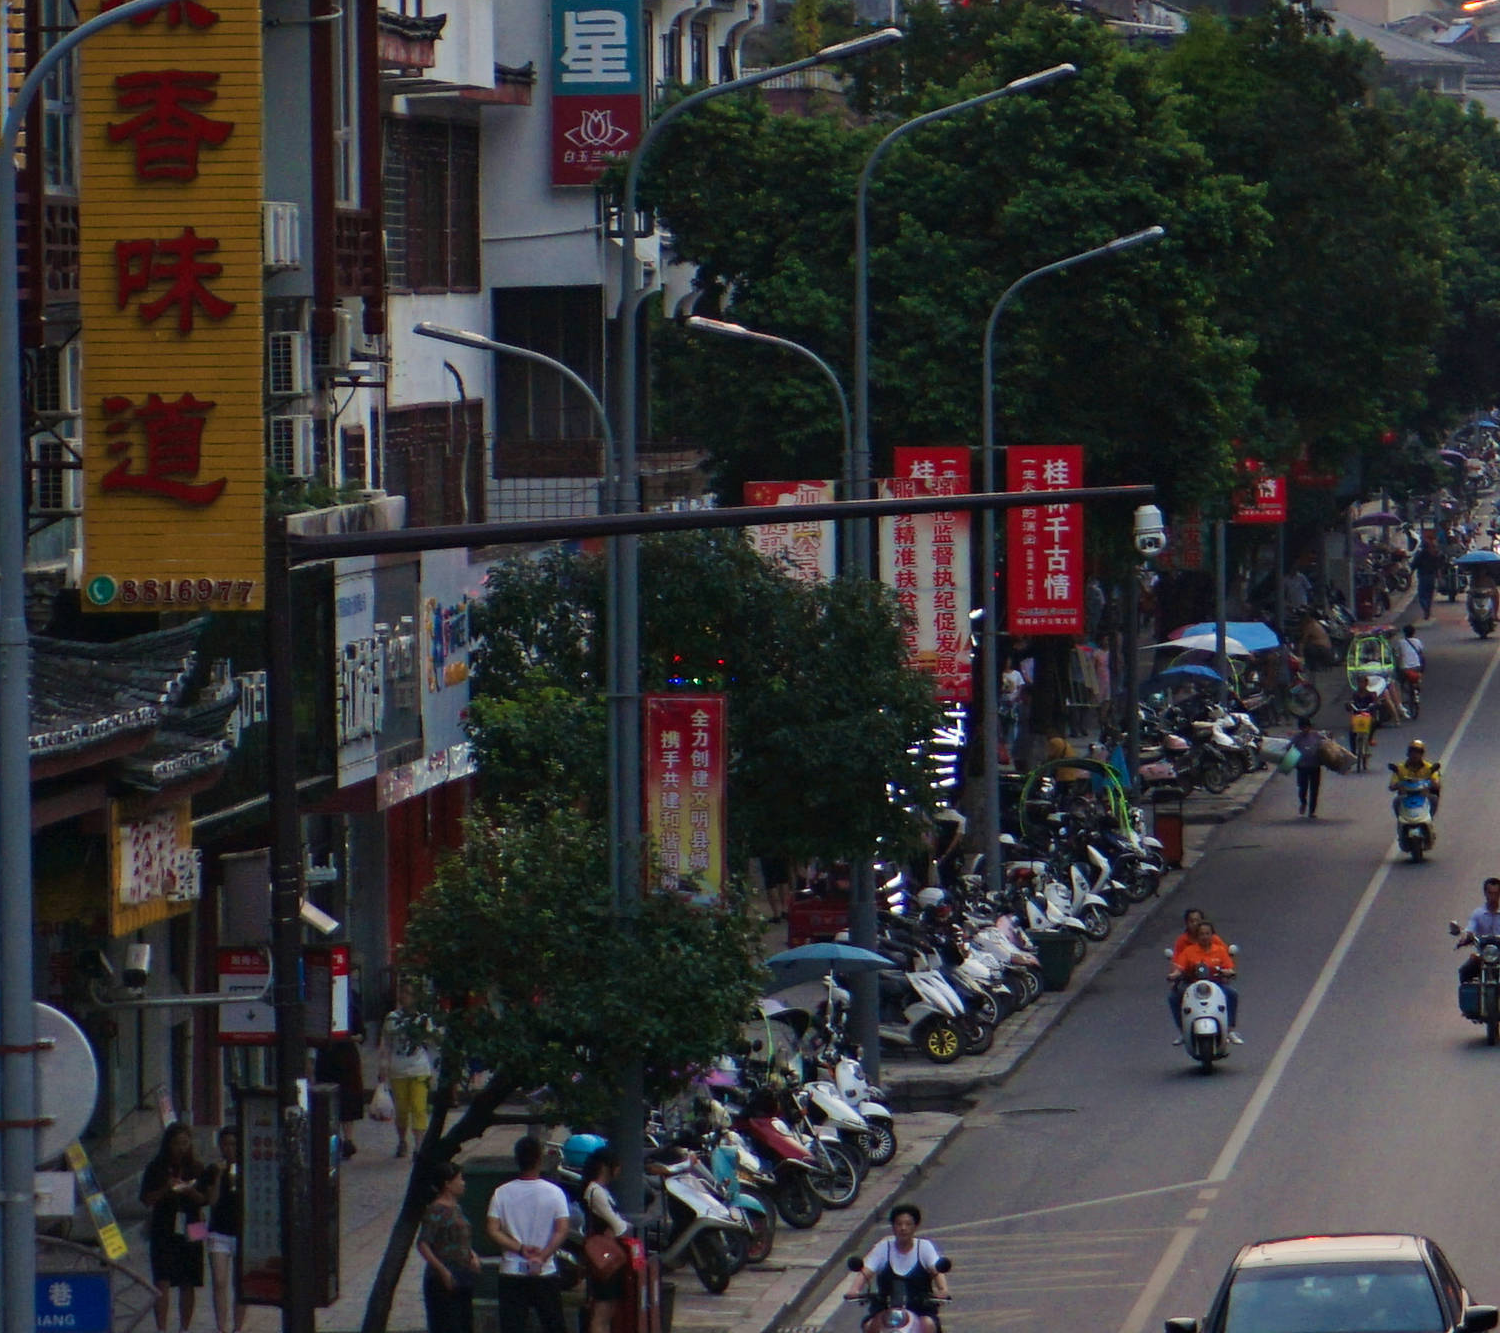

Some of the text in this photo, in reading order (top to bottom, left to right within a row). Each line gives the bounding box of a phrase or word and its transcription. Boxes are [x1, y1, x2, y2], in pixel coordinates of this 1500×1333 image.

[121, 578, 253, 606] 8816977
[659, 730, 682, 890] 携手共建和谐阳朔
[689, 708, 710, 869] 全力创建文明县城
